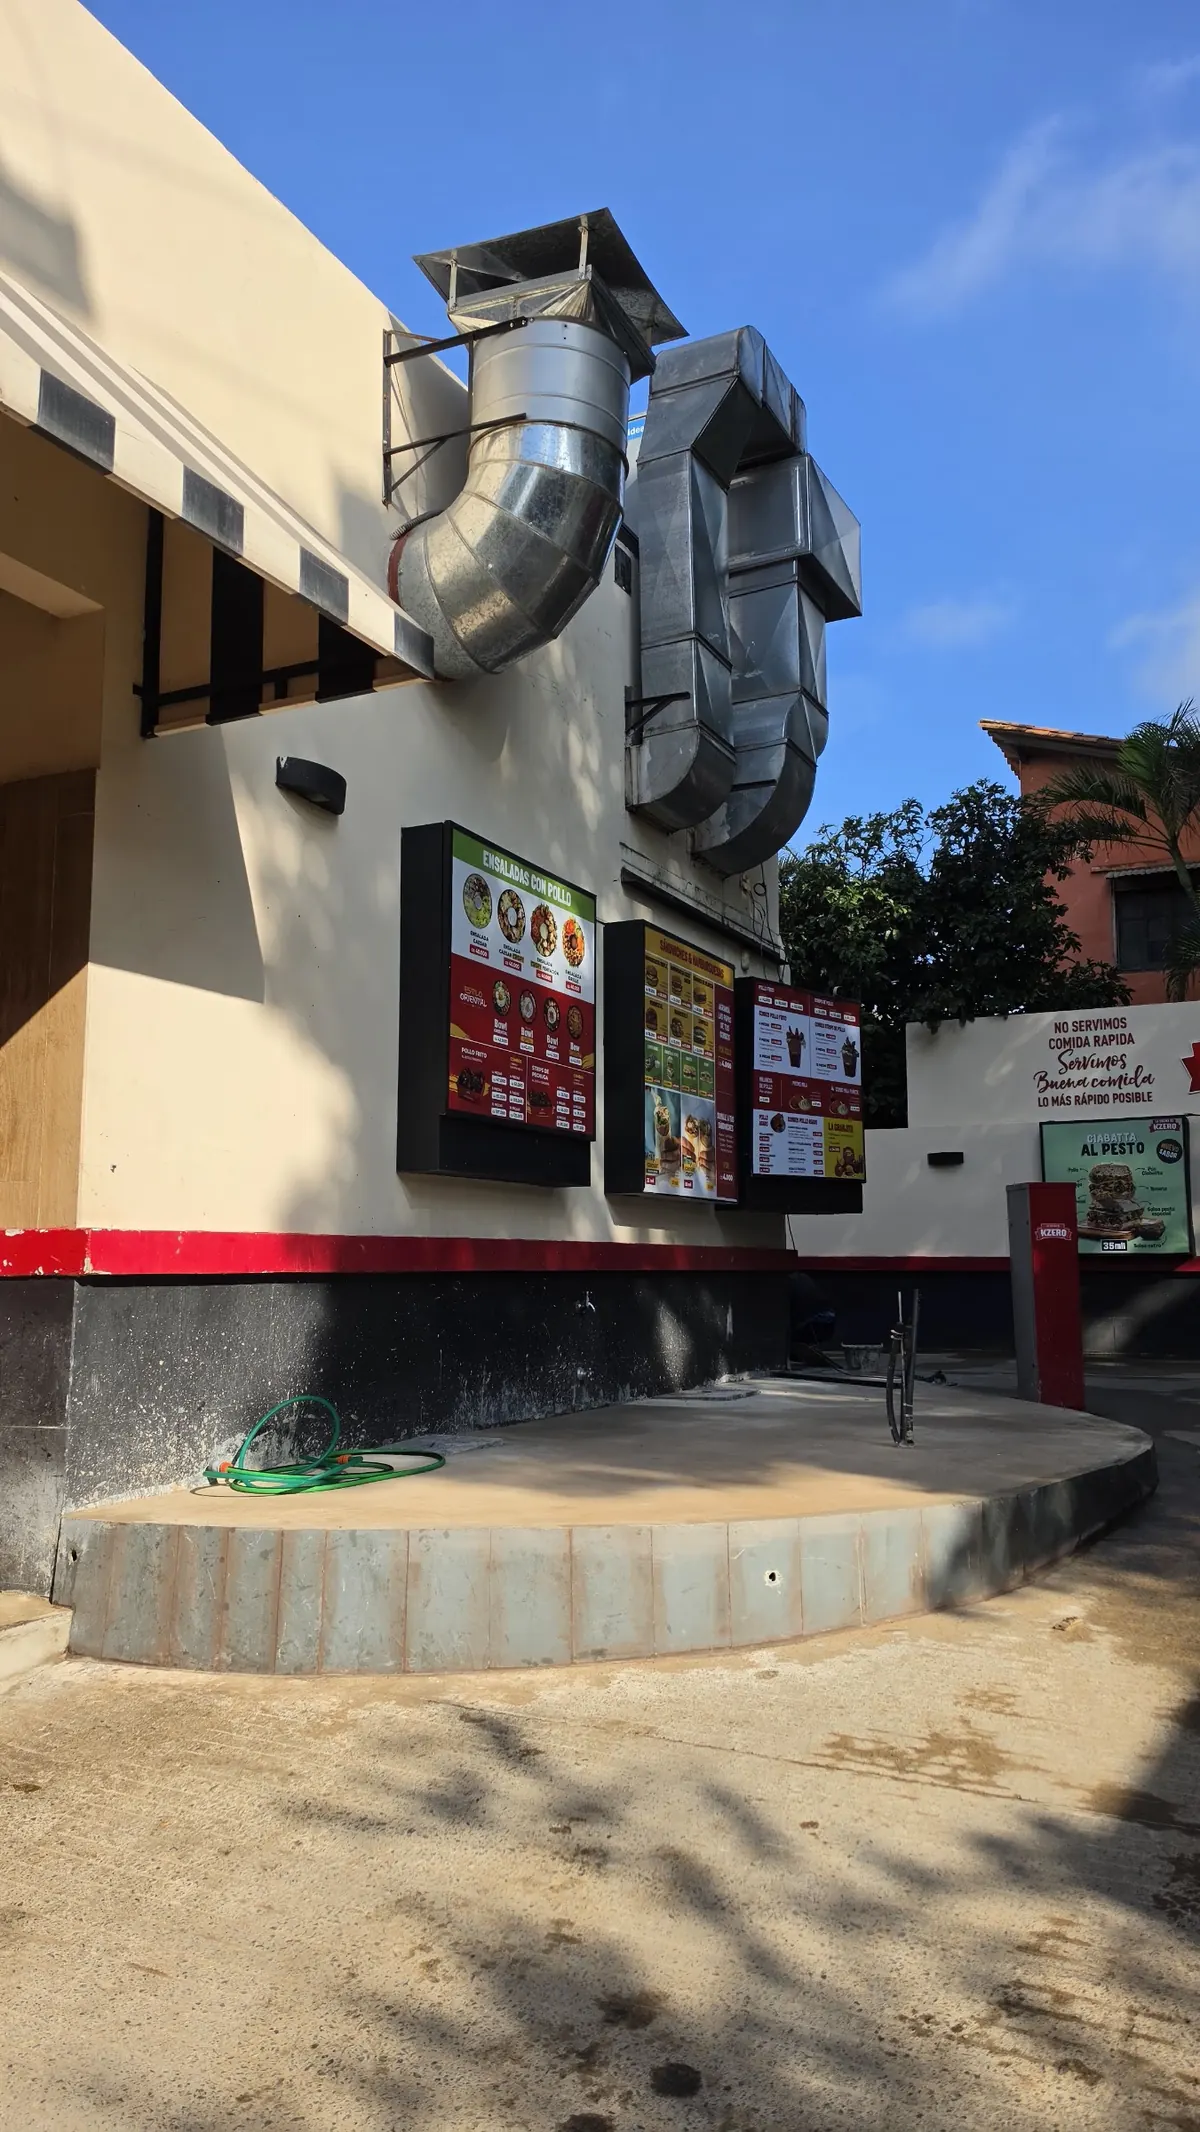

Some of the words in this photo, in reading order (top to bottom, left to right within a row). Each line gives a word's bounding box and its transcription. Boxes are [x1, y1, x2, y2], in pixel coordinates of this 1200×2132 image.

[482, 849, 530, 887] ENSALADAS
[531, 874, 546, 895] CON
[547, 882, 572, 907] POLLO
[494, 1018, 508, 1031] Bowl
[1054, 1021, 1069, 1034] NO
[1072, 1017, 1127, 1032] SERVIMOS
[521, 1027, 534, 1039] Bowl
[546, 1035, 559, 1046] Bowl
[1048, 1035, 1091, 1050] COMIDA
[1093, 1032, 1135, 1048] RAPIDA
[461, 1047, 475, 1057] POLLO
[475, 1050, 487, 1059] FRITO
[1057, 1048, 1127, 1075] Servimos
[1033, 1070, 1091, 1094] Buena
[1091, 1064, 1155, 1090] comida
[1038, 1096, 1049, 1107] LO
[1051, 1093, 1072, 1107] MÁS
[1074, 1092, 1110, 1106] RÁPIDO
[1112, 1091, 1153, 1104] POSIBLE
[1153, 1122, 1177, 1131] KZERO
[1087, 1132, 1137, 1143] CIABATTA
[1081, 1144, 1098, 1157] AL
[1101, 1141, 1145, 1156] PESTO
[1158, 1149, 1178, 1159] SABOR
[1040, 1228, 1067, 1238] KZERO
